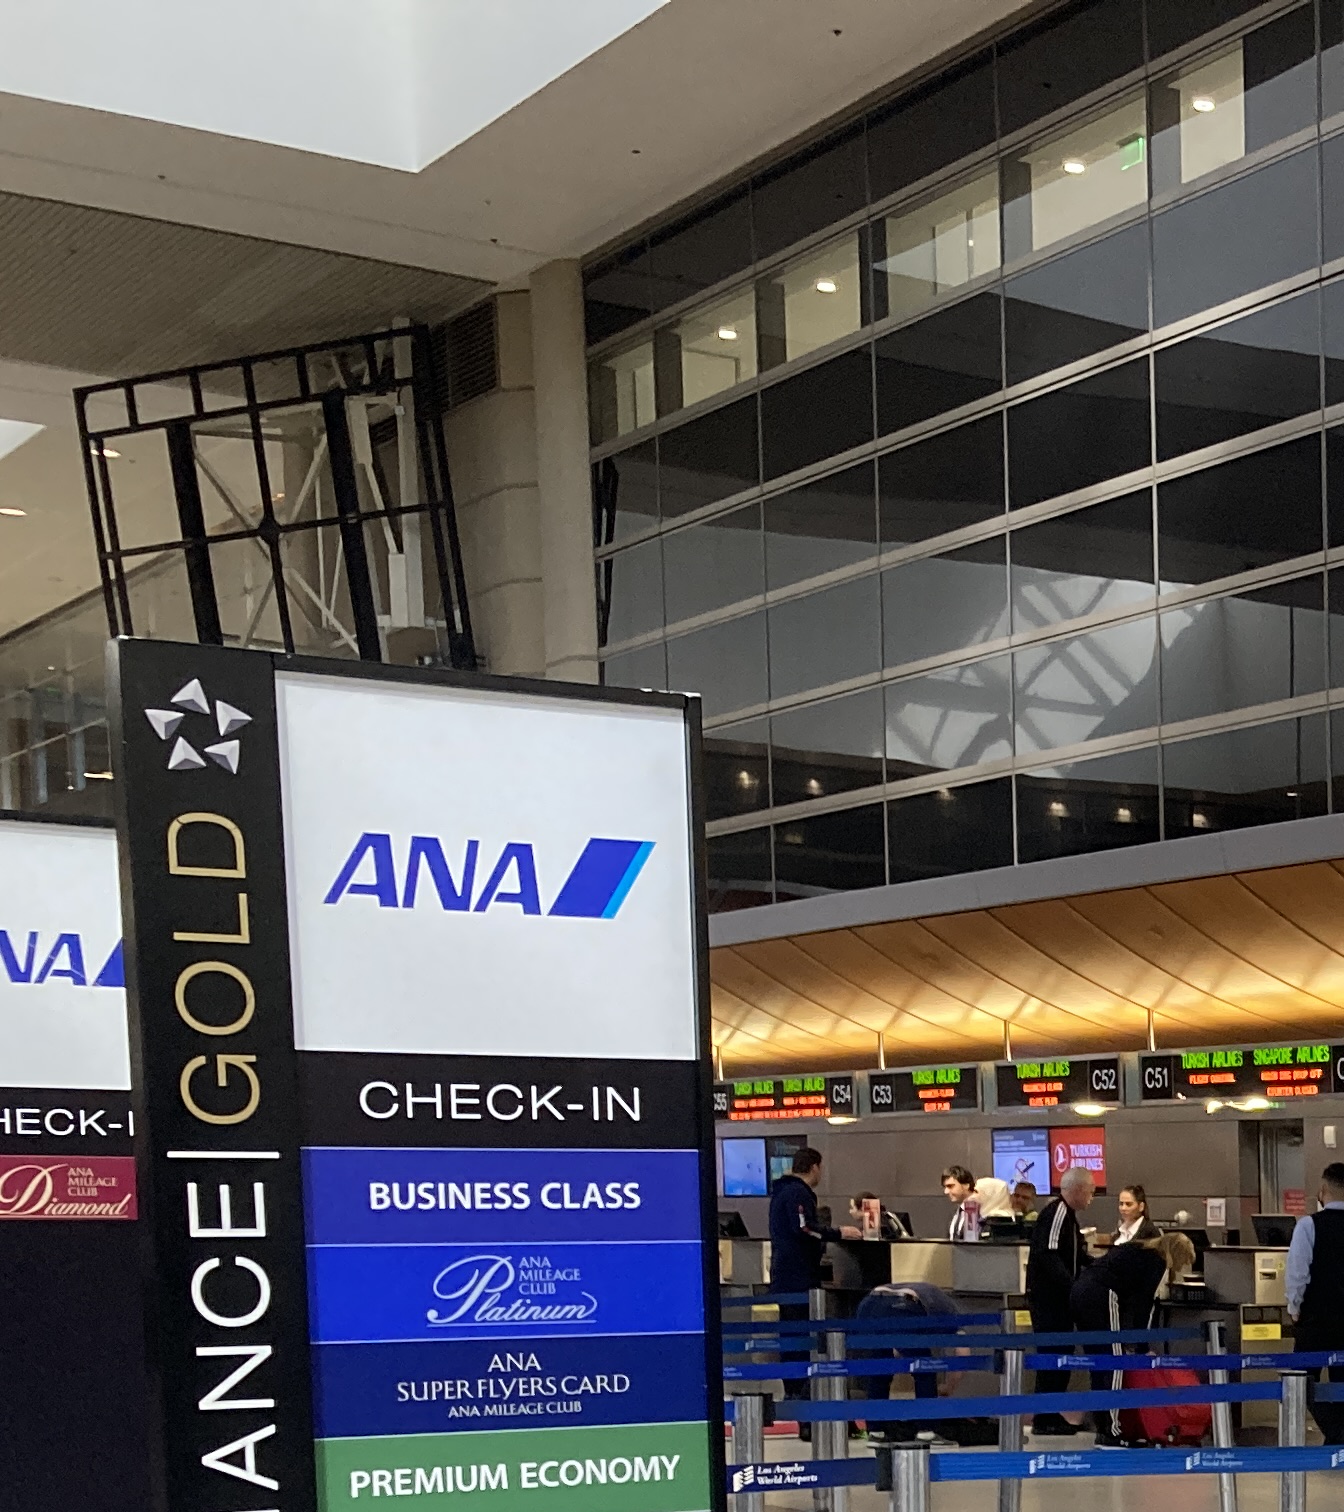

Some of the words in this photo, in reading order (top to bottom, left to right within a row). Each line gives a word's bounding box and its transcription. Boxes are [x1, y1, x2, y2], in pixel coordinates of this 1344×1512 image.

[323, 831, 542, 917] ANA
[0, 929, 88, 987] NA
[168, 811, 261, 1125] GOLD
[1296, 1045, 1330, 1062] AIRLINES
[1092, 1069, 1116, 1090] C52
[1144, 1067, 1168, 1088] C51
[359, 1081, 642, 1122] CHECK-IN
[713, 1092, 727, 1111] 55
[832, 1084, 852, 1104] C54
[872, 1084, 892, 1104] C53
[1069, 1144, 1103, 1158] TURKISH
[67, 1167, 94, 1177] ANA
[1069, 1157, 1104, 1171] AIRLINES
[0, 1164, 132, 1217] Diamond
[67, 1176, 118, 1187] MILEAGE
[67, 1186, 98, 1197] CLUB
[369, 1181, 532, 1211] BUSINESS
[540, 1181, 642, 1211] CLASS
[518, 1256, 552, 1269] ANA
[518, 1268, 582, 1282] MILEAGE
[427, 1254, 598, 1325] Platinum
[518, 1282, 557, 1295] CLUB
[487, 1352, 542, 1373] ANA
[397, 1380, 474, 1402] SUPER
[477, 1376, 557, 1400] FLYERS
[560, 1373, 631, 1396] CARD
[448, 1405, 482, 1419] ANA
[483, 1402, 545, 1417] MILEAGE
[546, 1400, 583, 1413] CLUB
[349, 1463, 509, 1499] PREMIUM
[520, 1454, 681, 1490] ECONOMY
[757, 1465, 771, 1475] Los
[774, 1463, 804, 1476] Angeles
[757, 1475, 782, 1485] World
[784, 1473, 818, 1486] Airports
